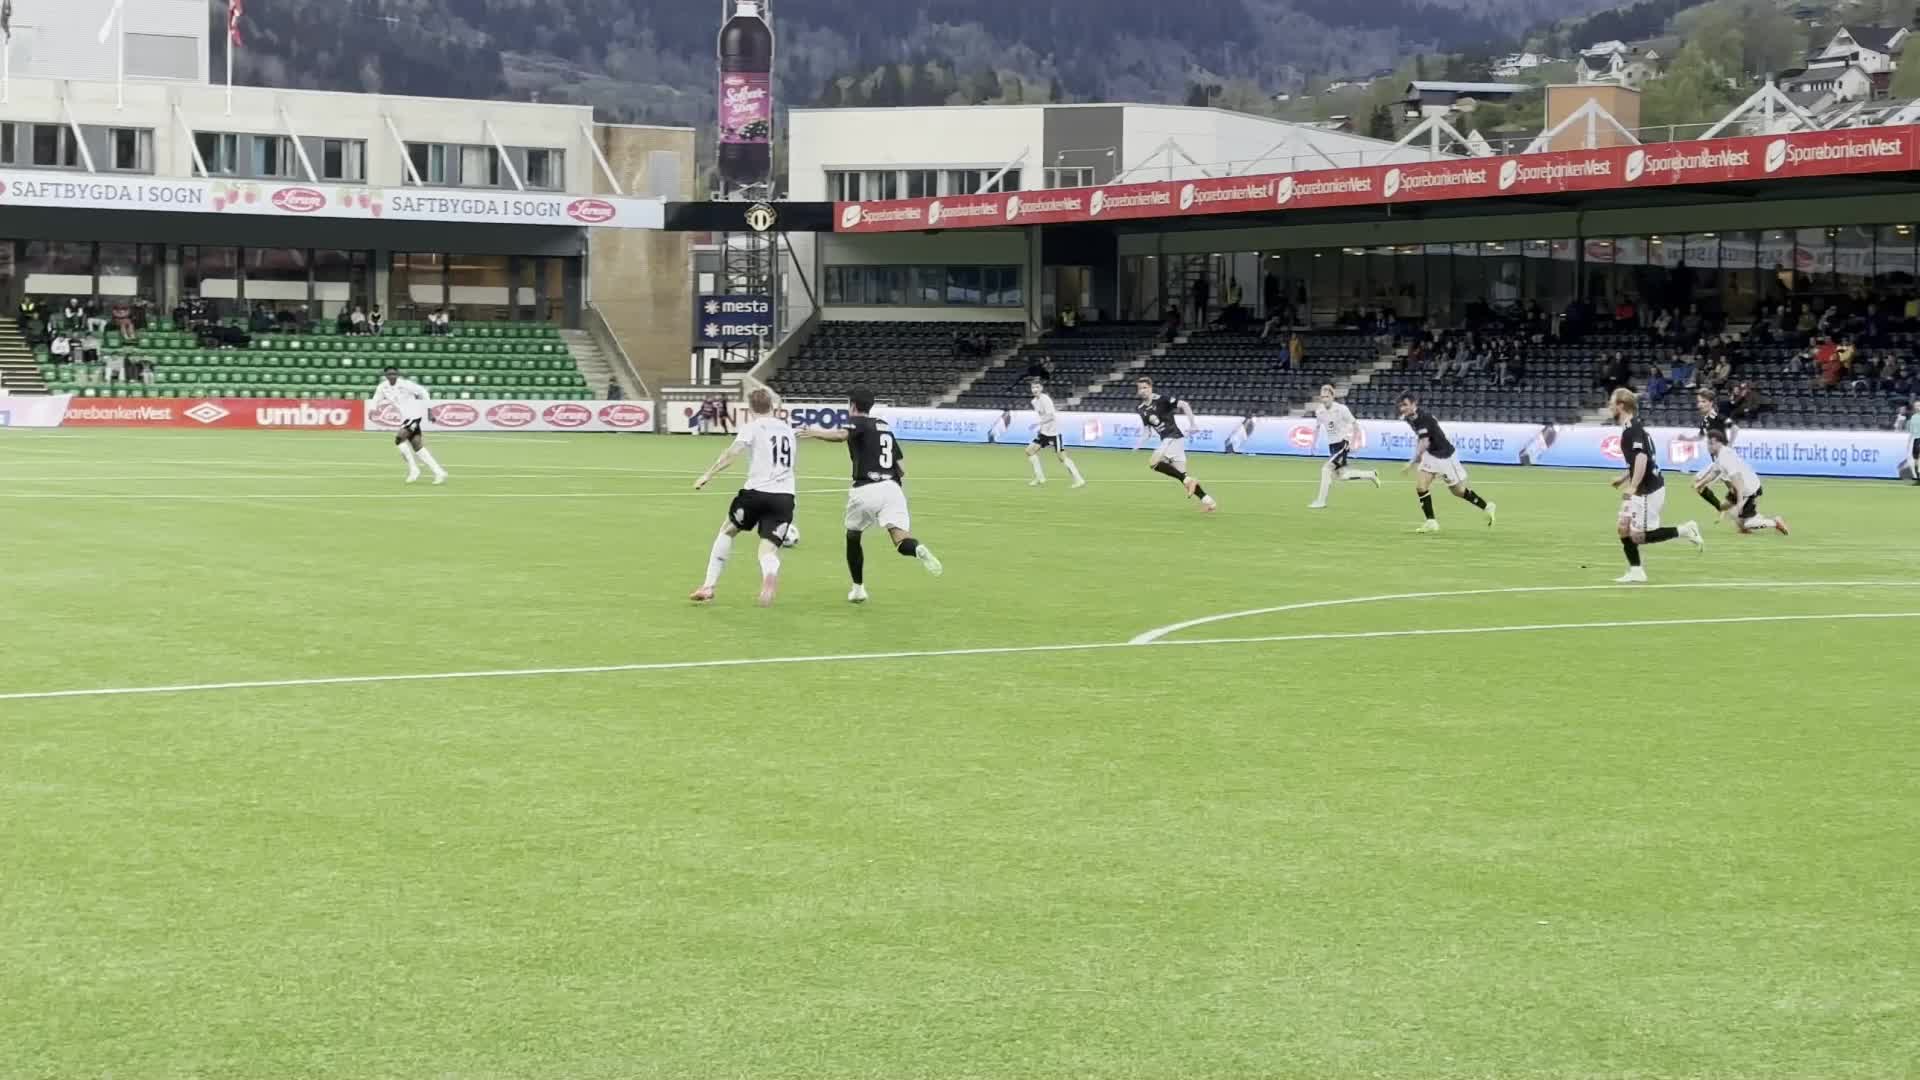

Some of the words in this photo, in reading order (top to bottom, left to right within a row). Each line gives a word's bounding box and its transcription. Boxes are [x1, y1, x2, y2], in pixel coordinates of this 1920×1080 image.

[1645, 150, 1750, 175] SparebankenVest
[1786, 138, 1902, 166] SparebankenVest
[1400, 169, 1487, 193] SparebankenVest
[1517, 159, 1611, 183] SparebankenVest
[12, 181, 132, 201] SAFTBYGDA
[138, 186, 143, 200] I
[148, 187, 202, 204] SOGN
[1193, 184, 1268, 208] SparebankenVest
[1292, 177, 1372, 200] SparebankenVest
[392, 196, 499, 216] SAFTBYGDA
[503, 201, 508, 215] I
[513, 202, 561, 217] SOGN
[722, 300, 768, 312] mesta
[722, 324, 769, 336] mesta
[255, 403, 350, 425] umbro
[771, 435, 791, 468] 19
[879, 434, 893, 469] 3
[1468, 437, 1481, 454] og
[1484, 434, 1505, 450] bær
[1776, 443, 1790, 461] til
[1793, 443, 1829, 462] frukt
[1832, 449, 1847, 467] og
[1851, 444, 1880, 463] bær
